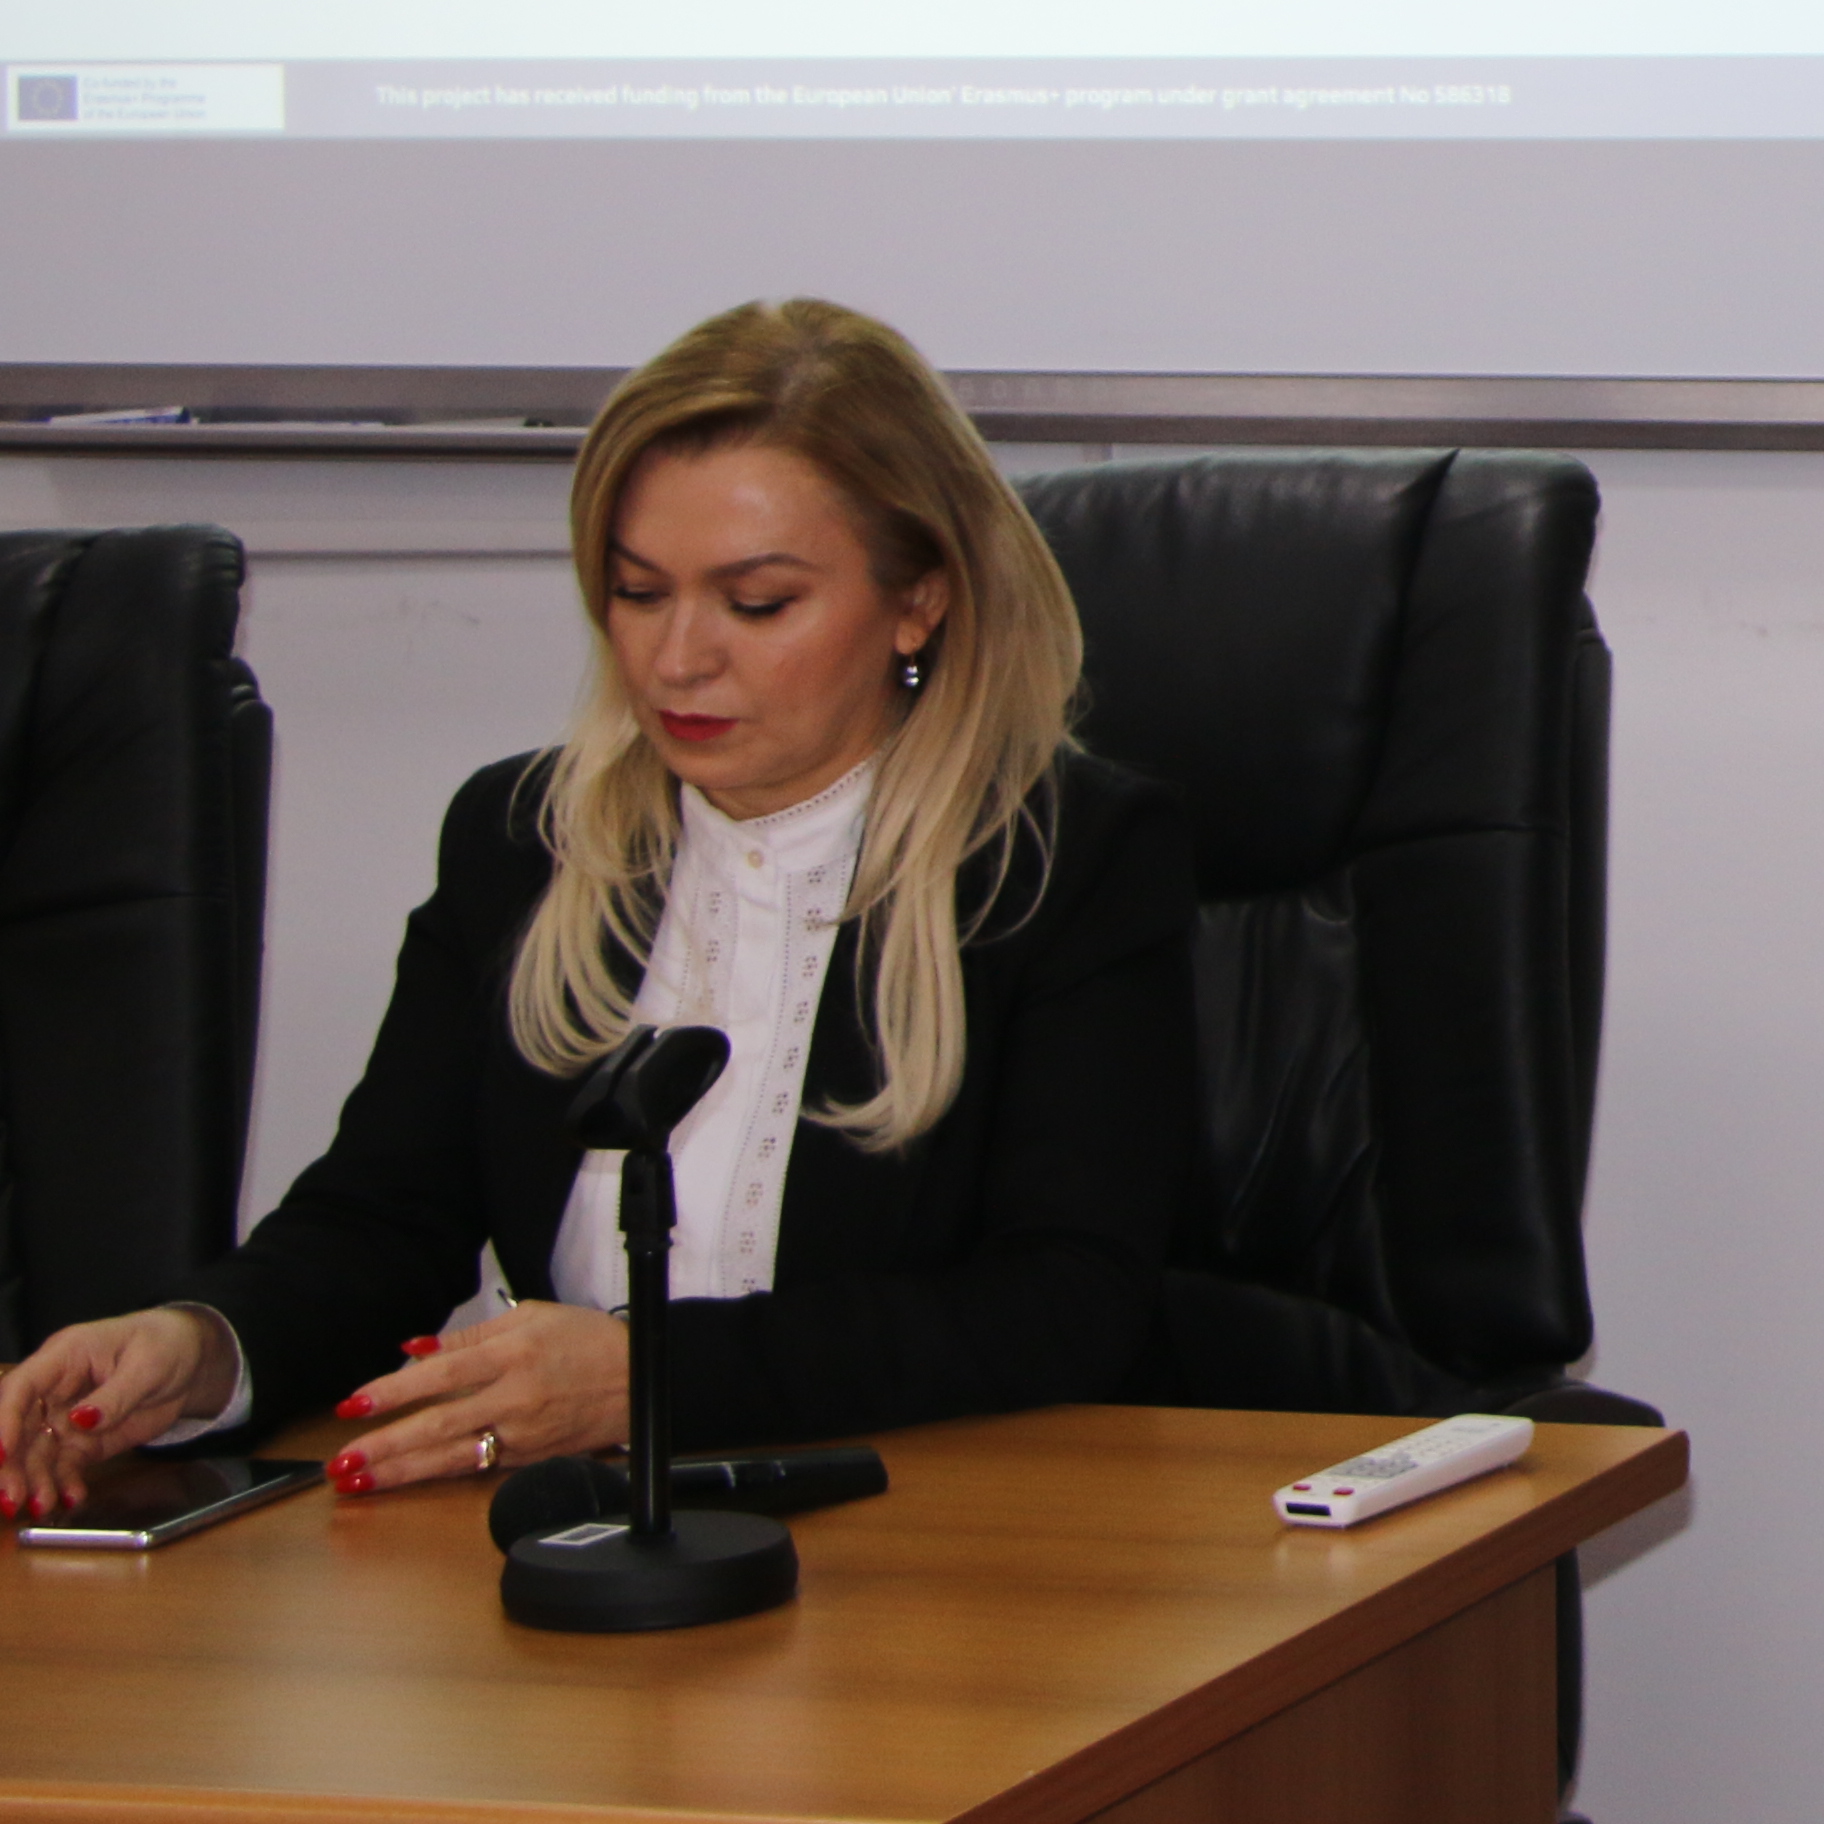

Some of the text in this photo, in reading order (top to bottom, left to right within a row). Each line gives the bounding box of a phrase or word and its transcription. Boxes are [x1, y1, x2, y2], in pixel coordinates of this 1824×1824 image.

[375, 84, 416, 106] This
[421, 84, 491, 112] project
[494, 84, 530, 106] has
[534, 84, 618, 106] received
[621, 84, 700, 112] funding
[703, 84, 750, 106] from
[754, 84, 787, 106] the
[791, 84, 888, 112] European
[1064, 84, 1153, 112] program
[1157, 84, 1217, 106] under
[1221, 84, 1278, 112] grant
[1282, 84, 1395, 112] agreement
[1400, 84, 1430, 106] No
